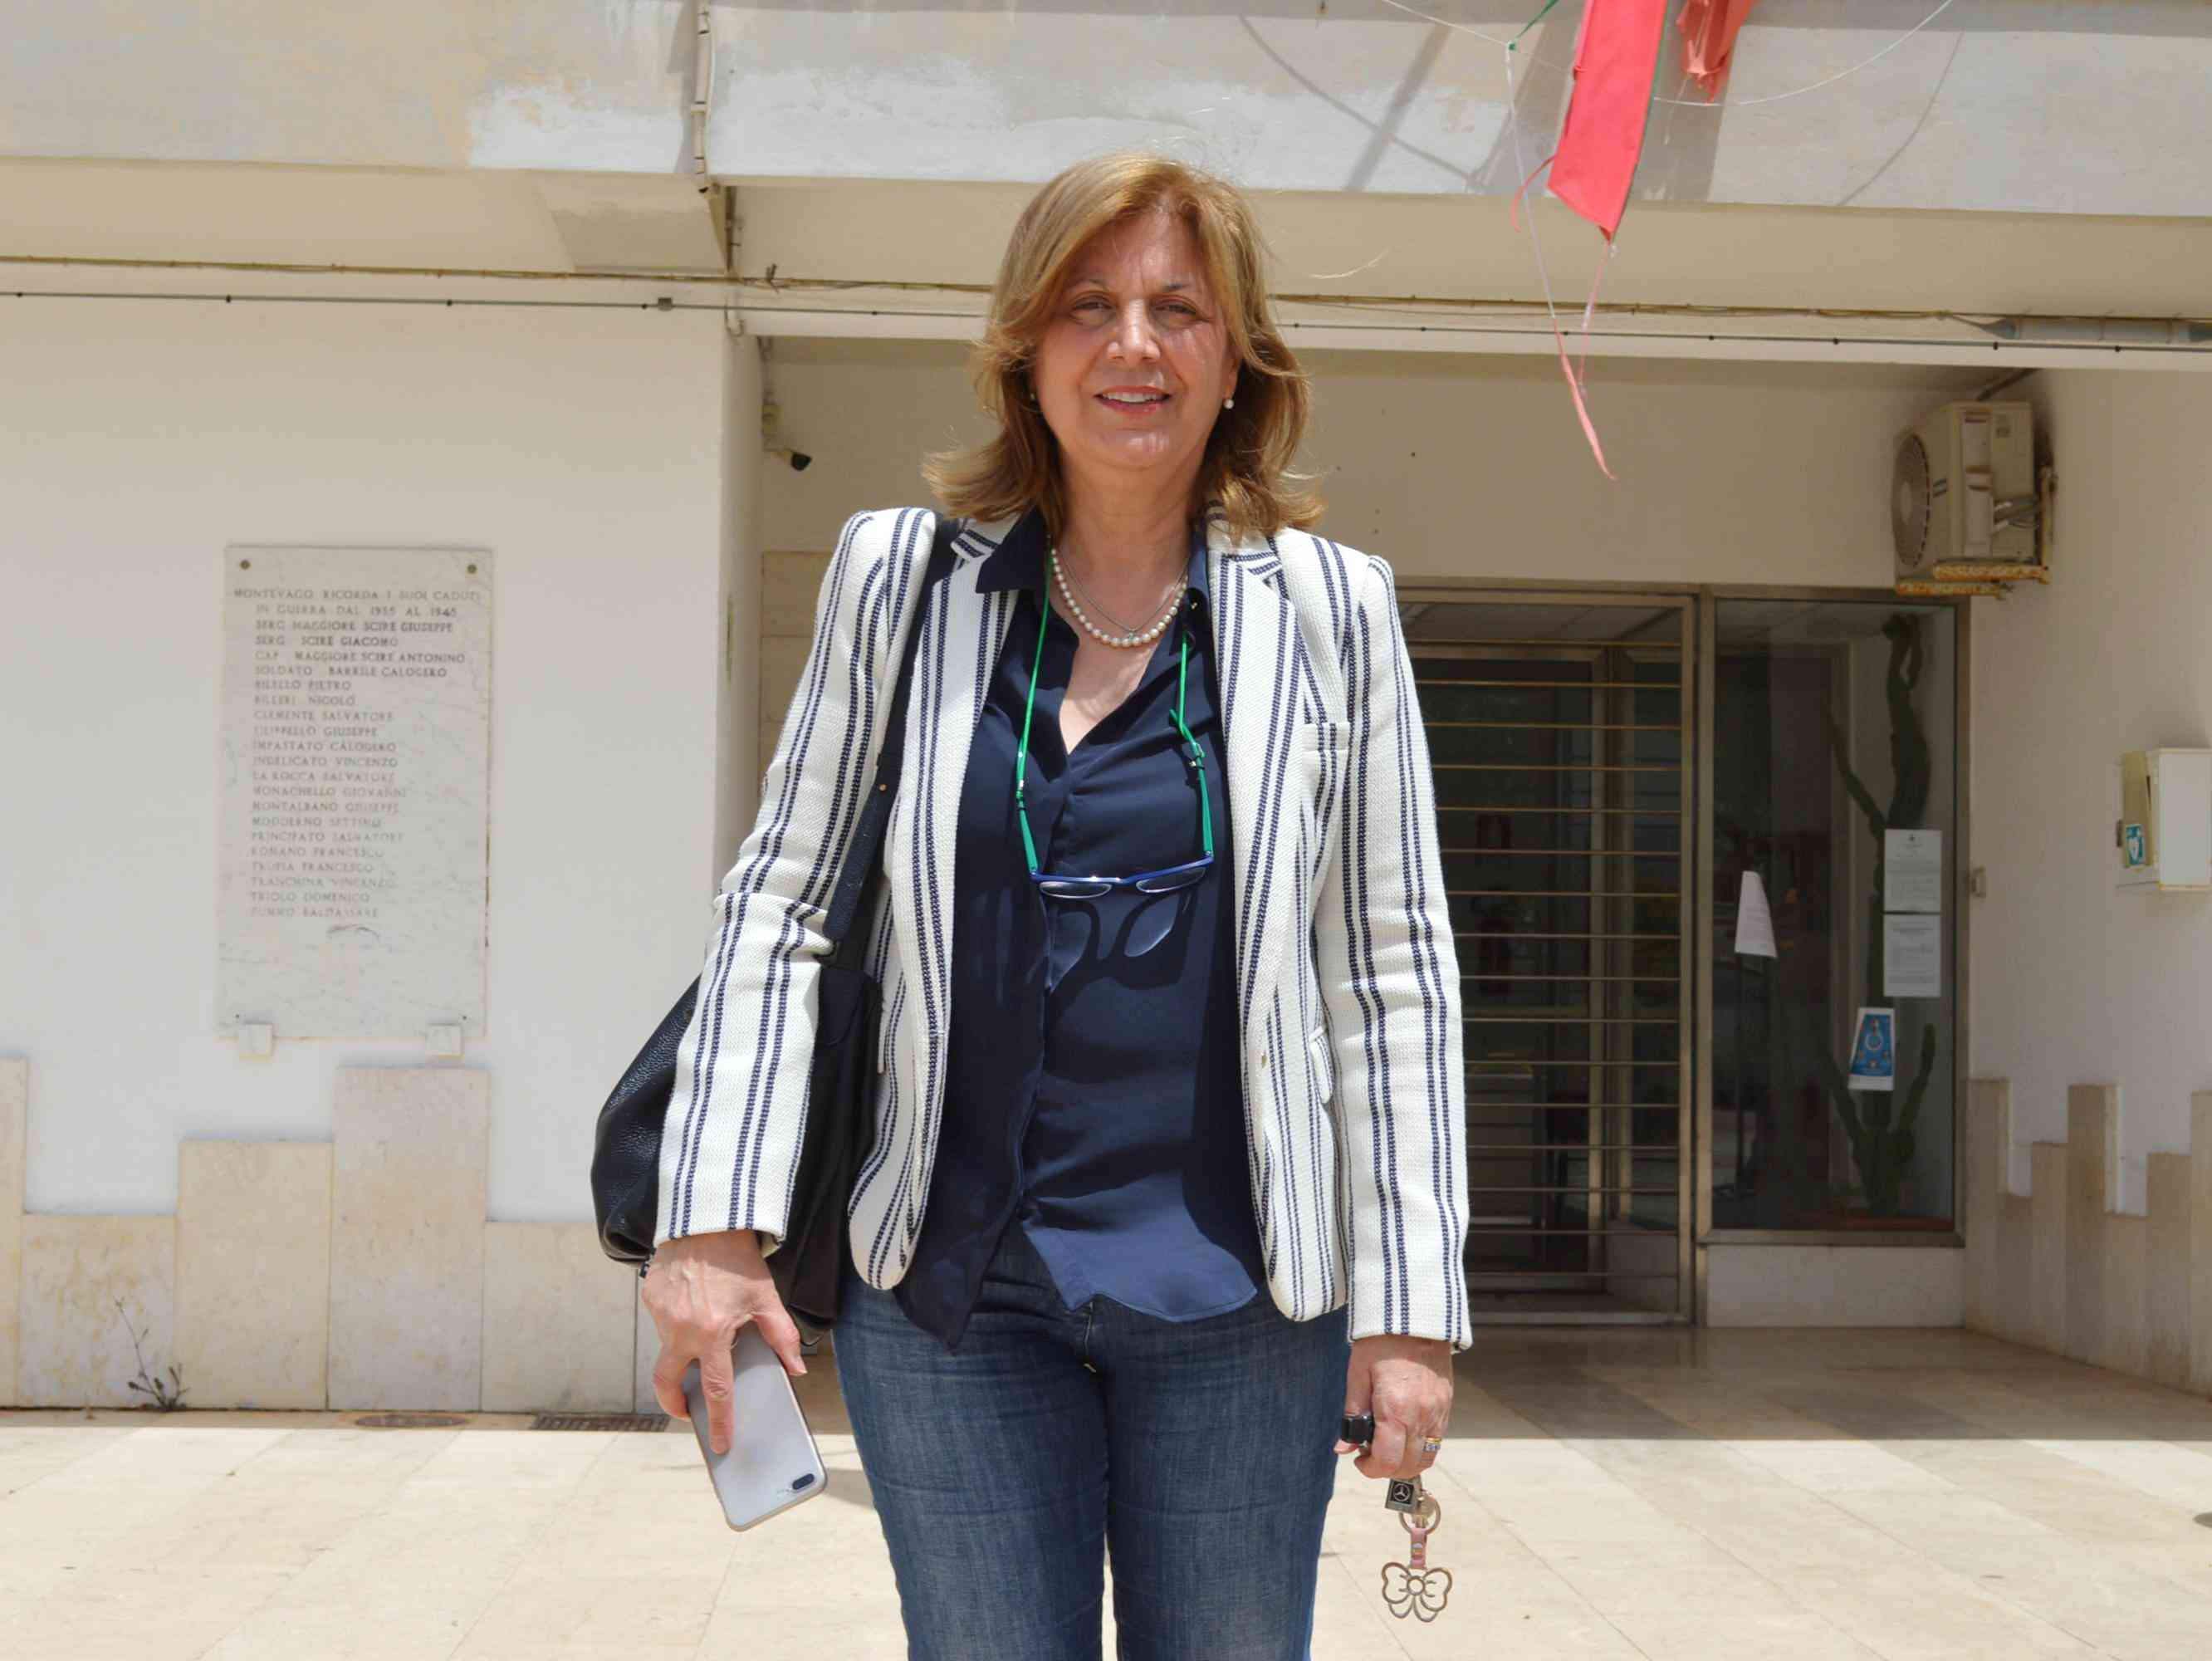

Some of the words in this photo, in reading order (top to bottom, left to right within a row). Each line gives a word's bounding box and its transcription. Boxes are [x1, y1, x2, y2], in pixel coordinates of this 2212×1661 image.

[233, 589, 314, 599] MONTEVAGO
[323, 590, 379, 600] RICORDA
[405, 606, 421, 616] AL
[340, 636, 399, 647] GIACOMO
[399, 653, 465, 664] ANTONINO
[381, 667, 448, 678] CALOGERO
[252, 801, 339, 811] MONTALBANO
